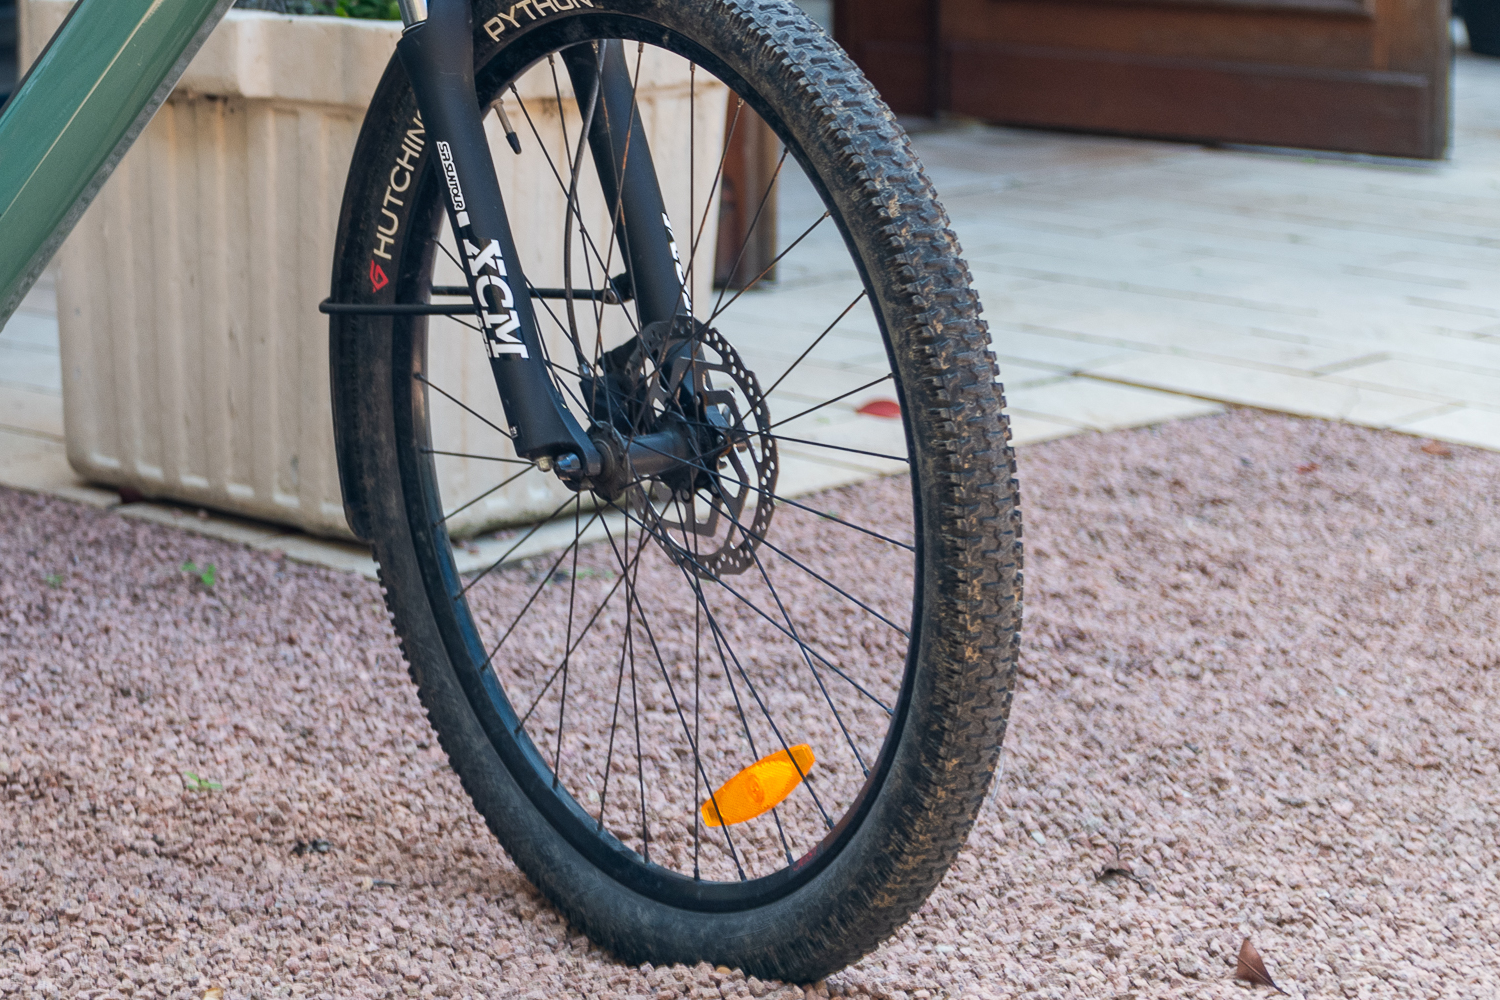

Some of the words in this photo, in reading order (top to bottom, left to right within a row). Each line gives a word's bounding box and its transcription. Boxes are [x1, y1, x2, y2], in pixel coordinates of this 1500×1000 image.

[373, 109, 426, 260] HUTCHIN
[443, 161, 465, 210] SUNTOUR
[462, 238, 530, 360] XCM
